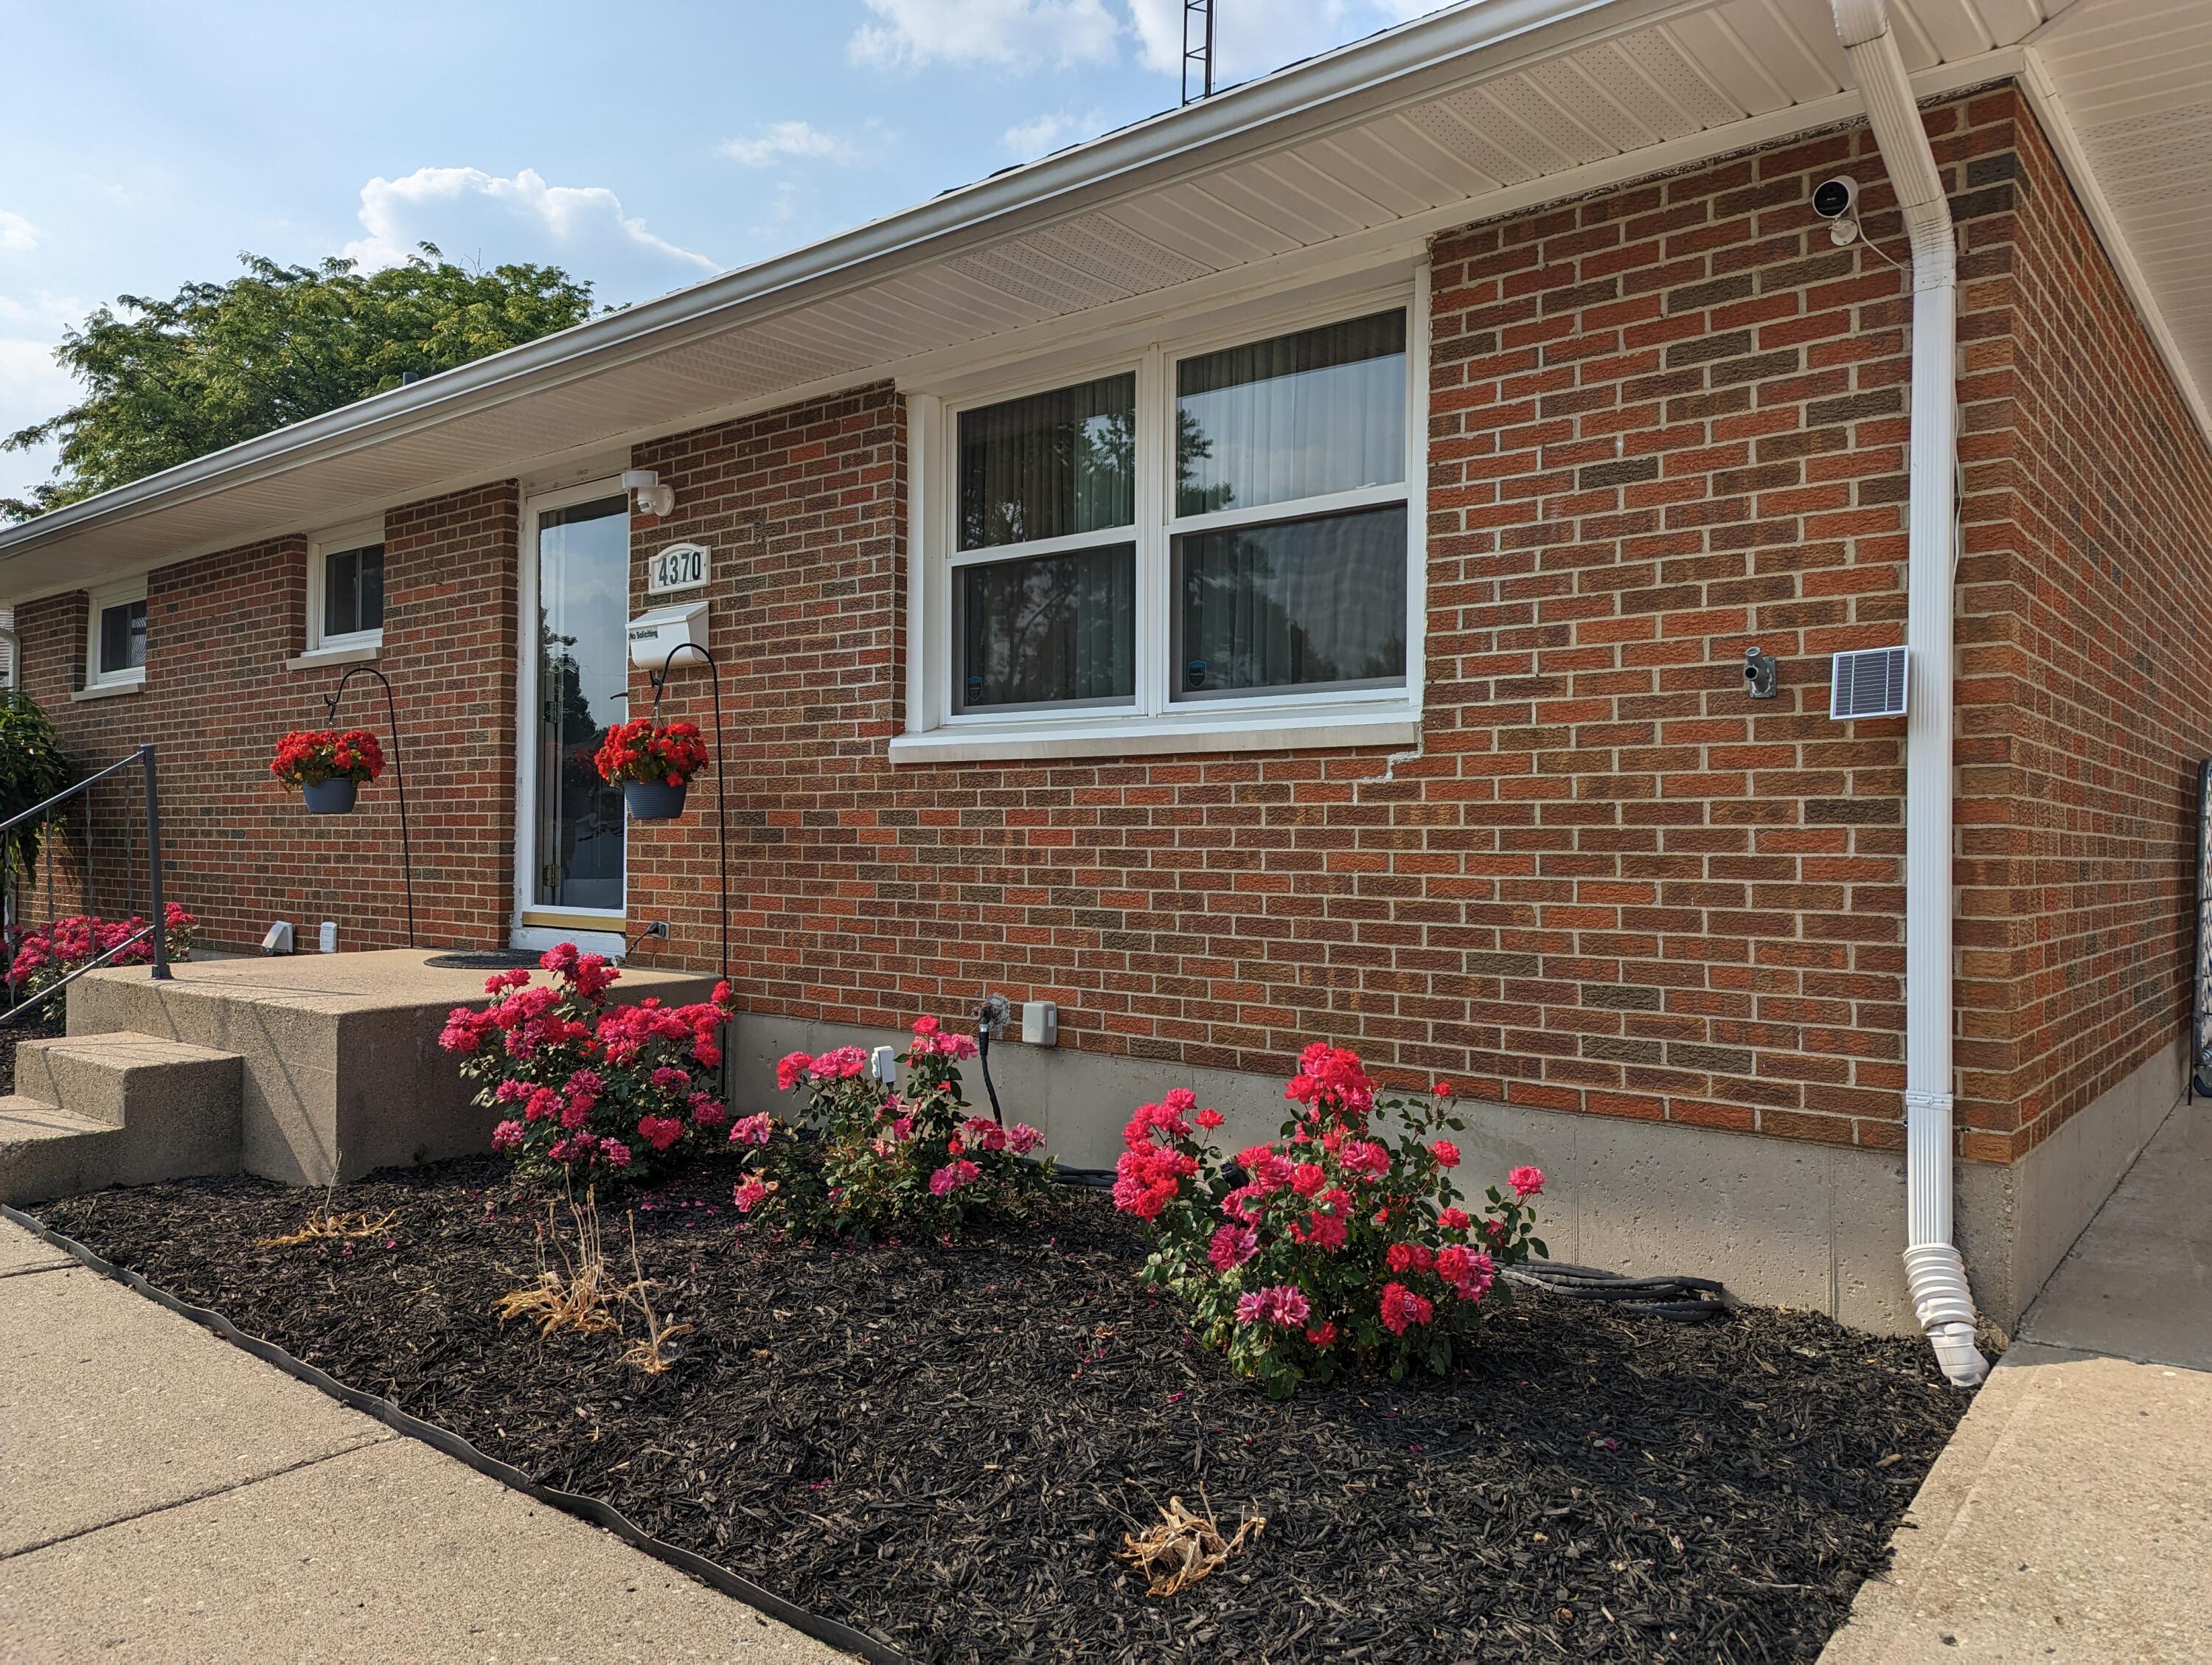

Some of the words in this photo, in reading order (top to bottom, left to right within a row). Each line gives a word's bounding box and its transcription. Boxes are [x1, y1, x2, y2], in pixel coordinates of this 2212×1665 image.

[658, 552, 701, 585] 4370
[629, 632, 636, 640] No
[636, 630, 658, 639] Soliciting
